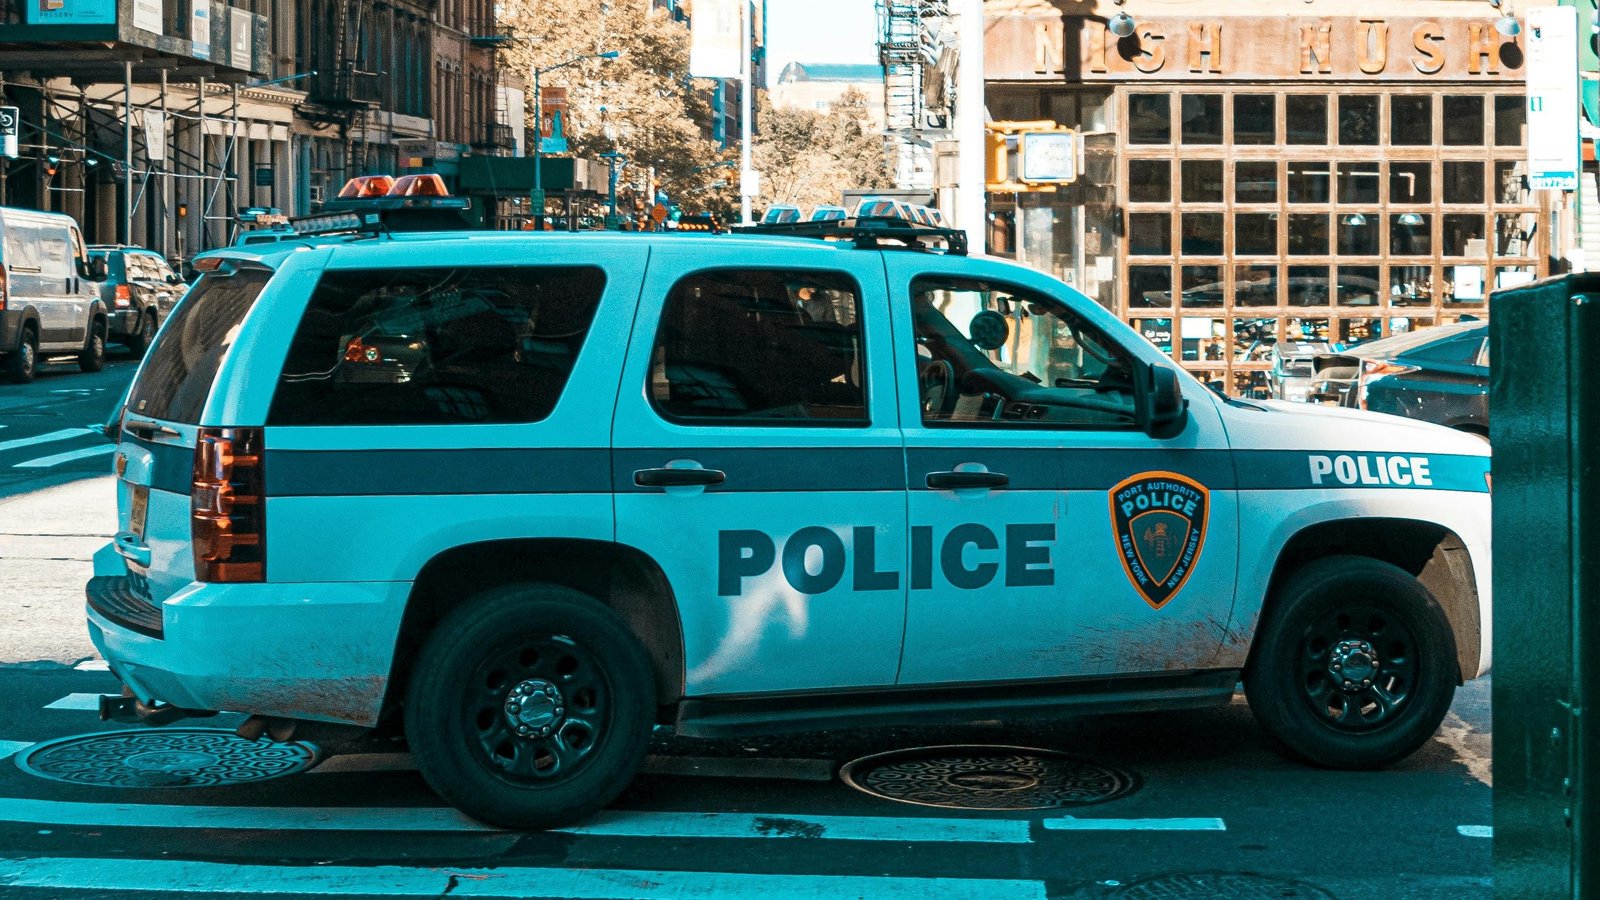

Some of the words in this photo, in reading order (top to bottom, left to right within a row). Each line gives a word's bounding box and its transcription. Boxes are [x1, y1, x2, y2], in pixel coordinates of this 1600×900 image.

[1034, 21, 1223, 75] NISH
[1300, 18, 1500, 75] NUSH
[1118, 484, 1142, 502] PORT
[1147, 482, 1201, 502] AUTHORITY
[1308, 455, 1433, 486] POLICE
[1121, 492, 1197, 517] POLICE
[718, 523, 1055, 596] POLICE
[1121, 534, 1132, 558] NEW
[1130, 558, 1148, 585] YORK
[1167, 566, 1185, 589] NEW
[1183, 528, 1200, 566] JERSEY
